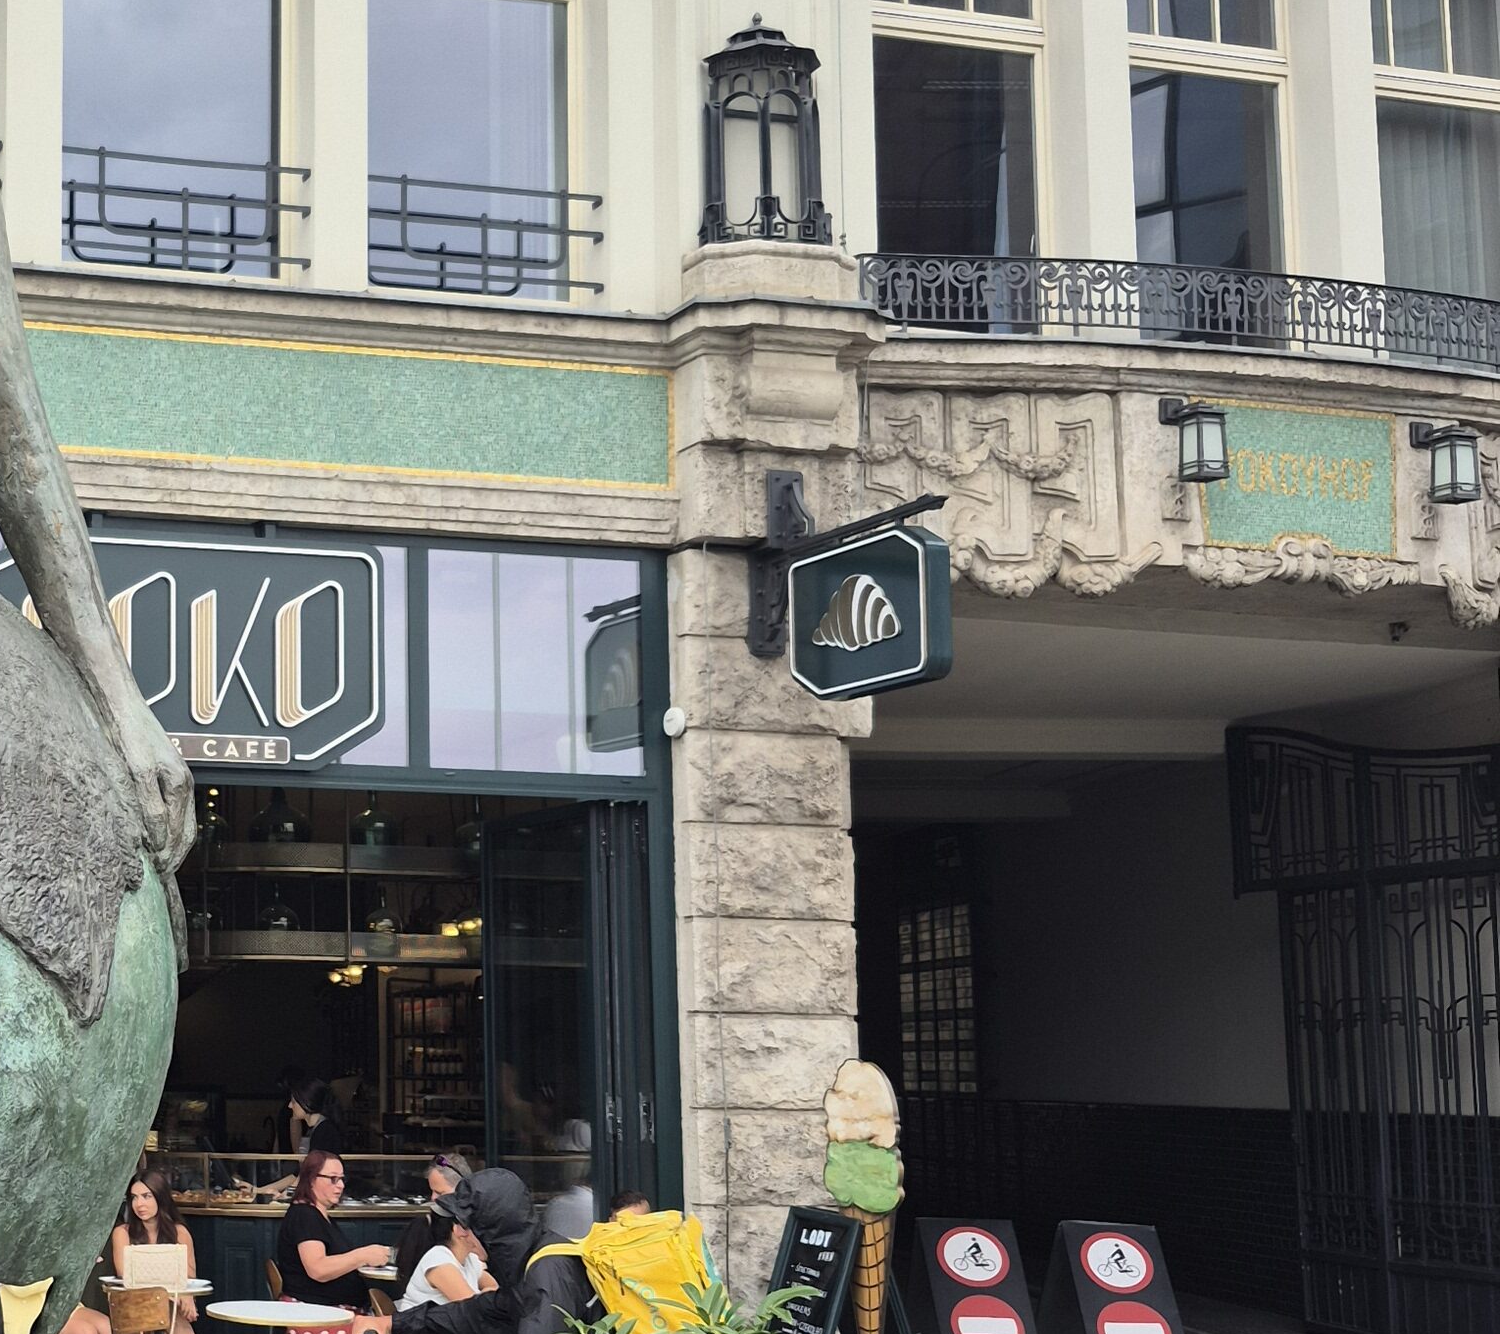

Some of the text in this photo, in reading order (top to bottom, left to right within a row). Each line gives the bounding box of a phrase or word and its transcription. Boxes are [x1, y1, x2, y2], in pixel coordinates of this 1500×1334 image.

[21, 571, 345, 728] OKO
[202, 738, 277, 760] CAFÉ
[799, 1228, 833, 1249] LODY
